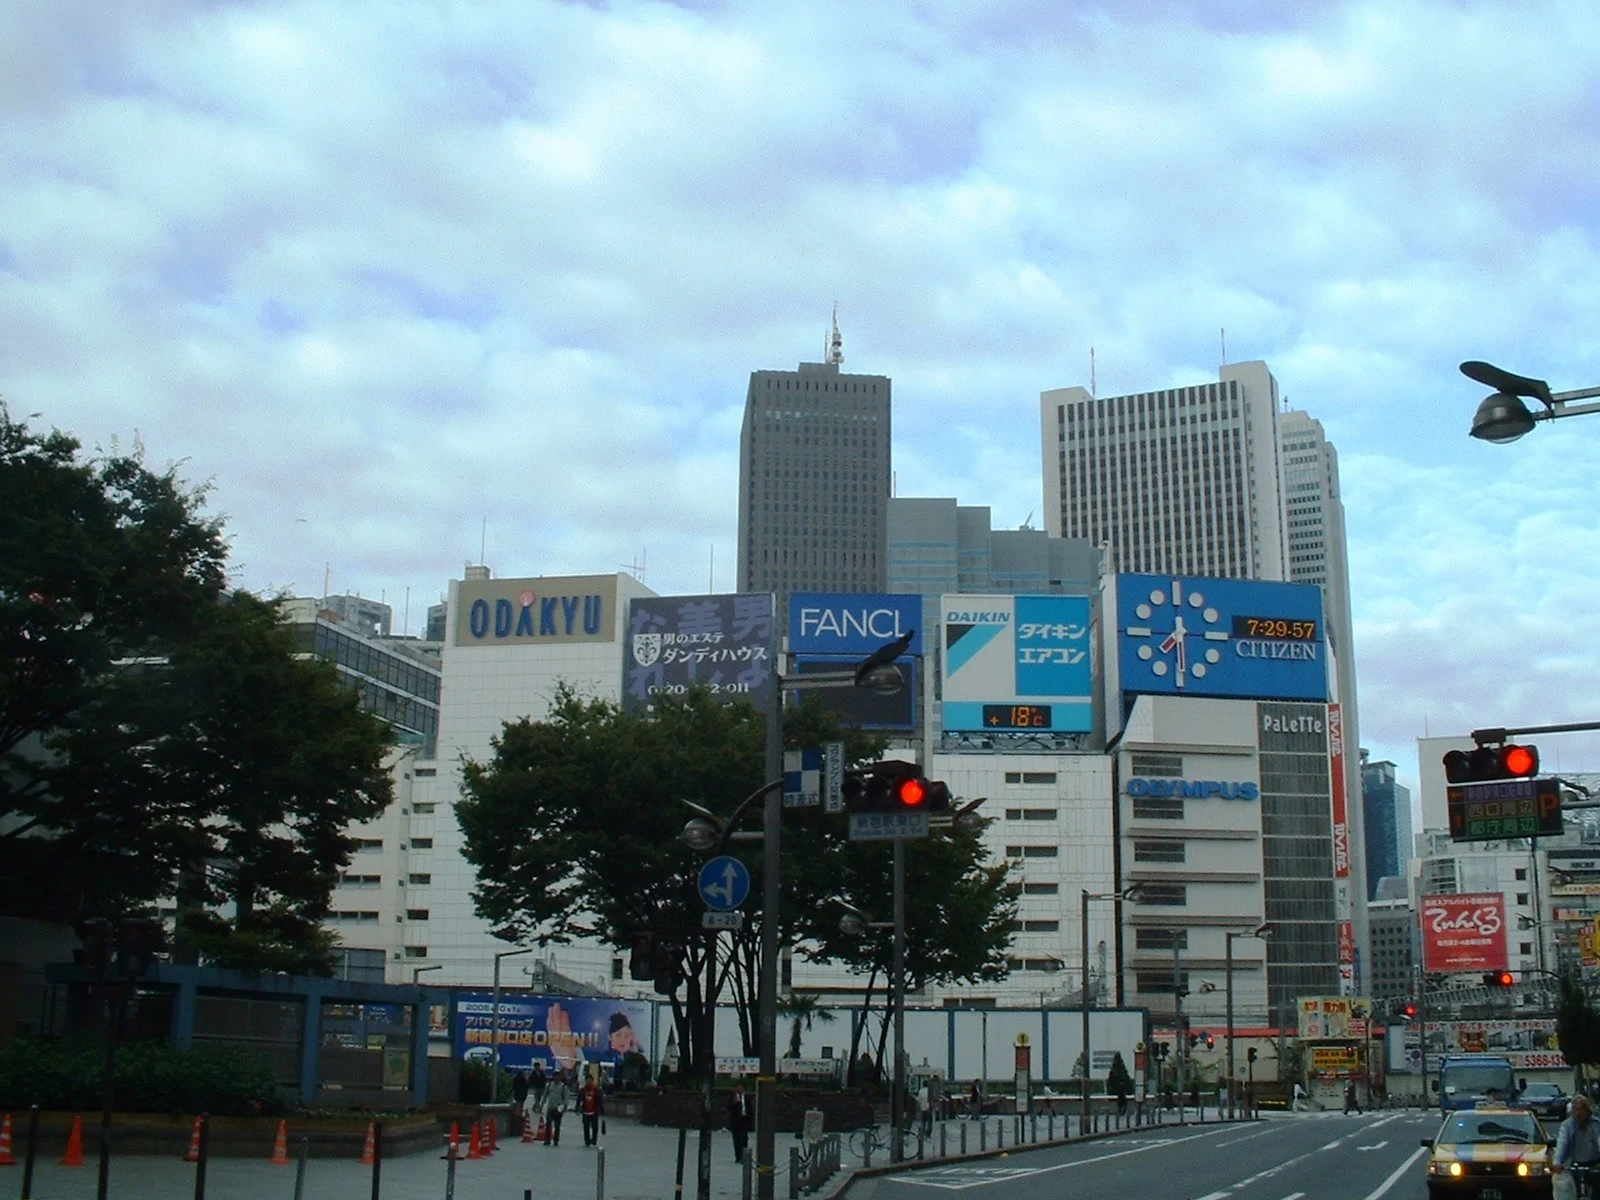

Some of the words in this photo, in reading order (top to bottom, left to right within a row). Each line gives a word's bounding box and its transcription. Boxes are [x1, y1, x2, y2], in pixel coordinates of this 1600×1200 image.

[469, 592, 602, 638] ODAKYU
[800, 608, 907, 639] FANCL
[946, 610, 1010, 623] DAIKIN
[663, 632, 725, 647] 男のエステ
[1018, 622, 1086, 641] ダイキン
[662, 646, 768, 665] ダンディハウス
[1018, 647, 1086, 664] エアコン
[1235, 638, 1317, 661] CITIZEN
[1126, 777, 1260, 801] OLYMPUS
